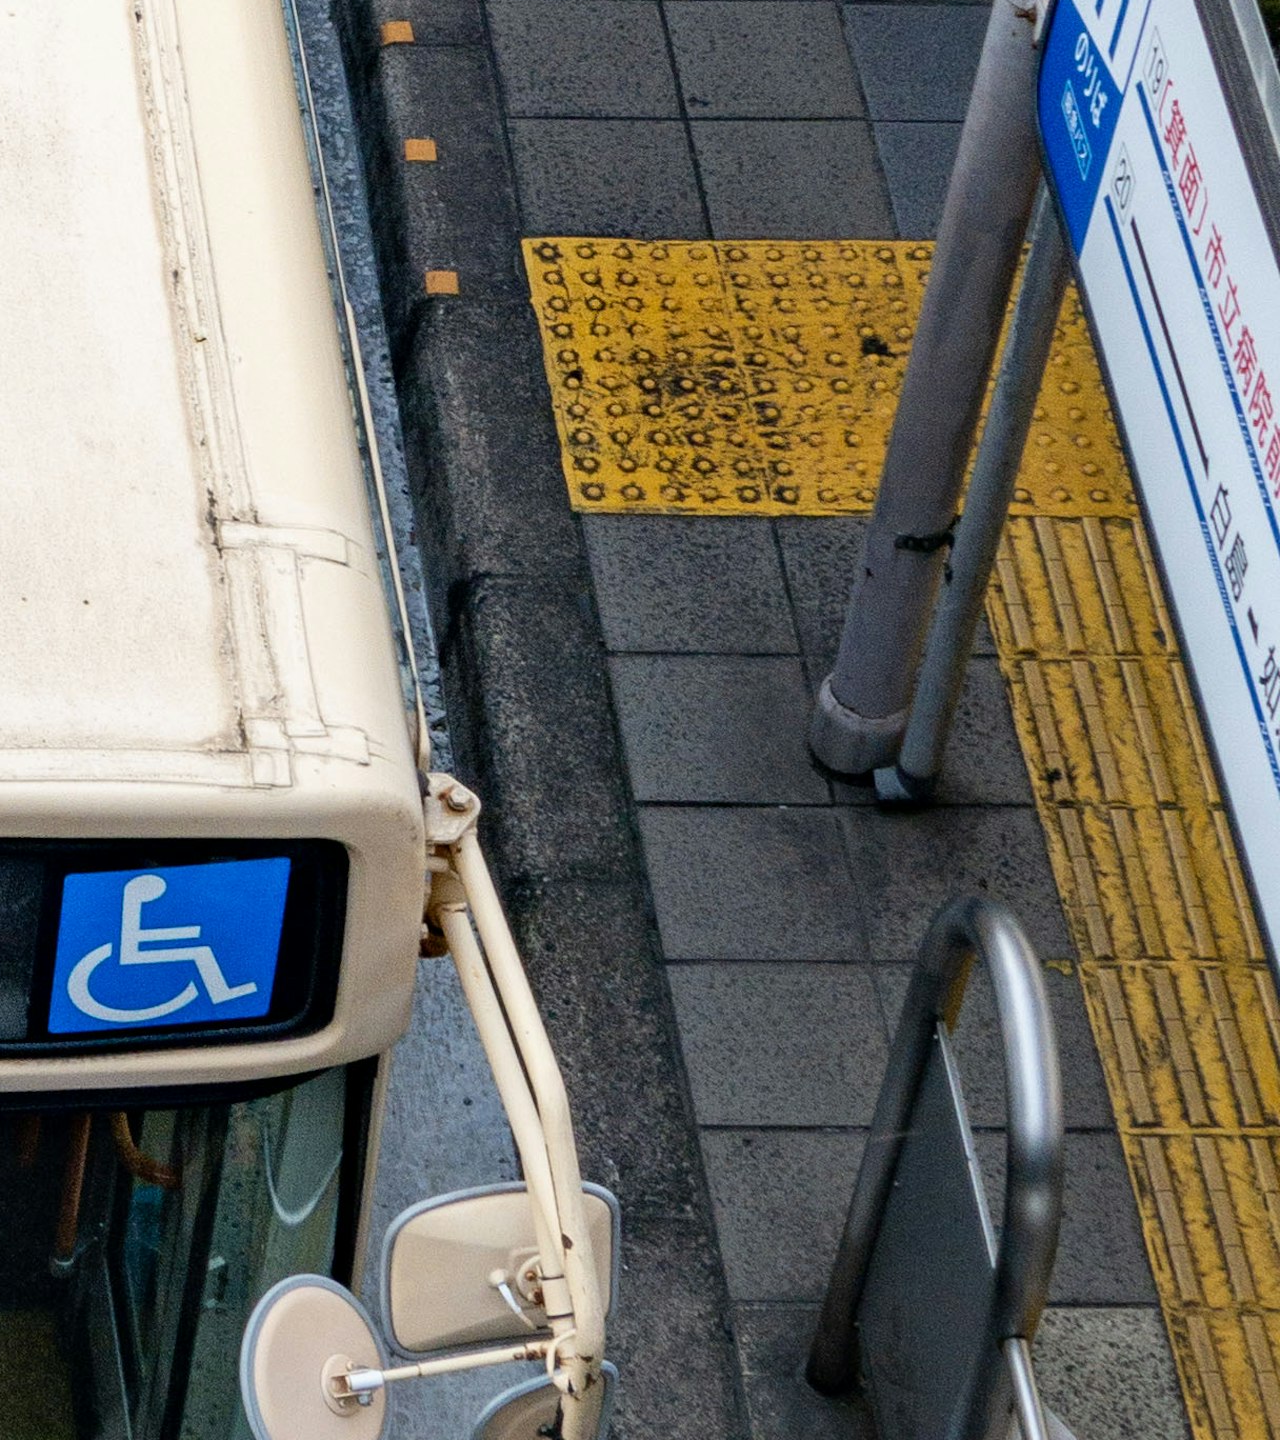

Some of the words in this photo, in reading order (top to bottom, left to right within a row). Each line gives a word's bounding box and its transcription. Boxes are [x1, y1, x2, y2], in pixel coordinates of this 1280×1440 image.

[1074, 31, 1109, 129] のりば
[1147, 46, 1164, 95] 19
[1113, 157, 1131, 211] 20
[1209, 481, 1249, 603] 白島
